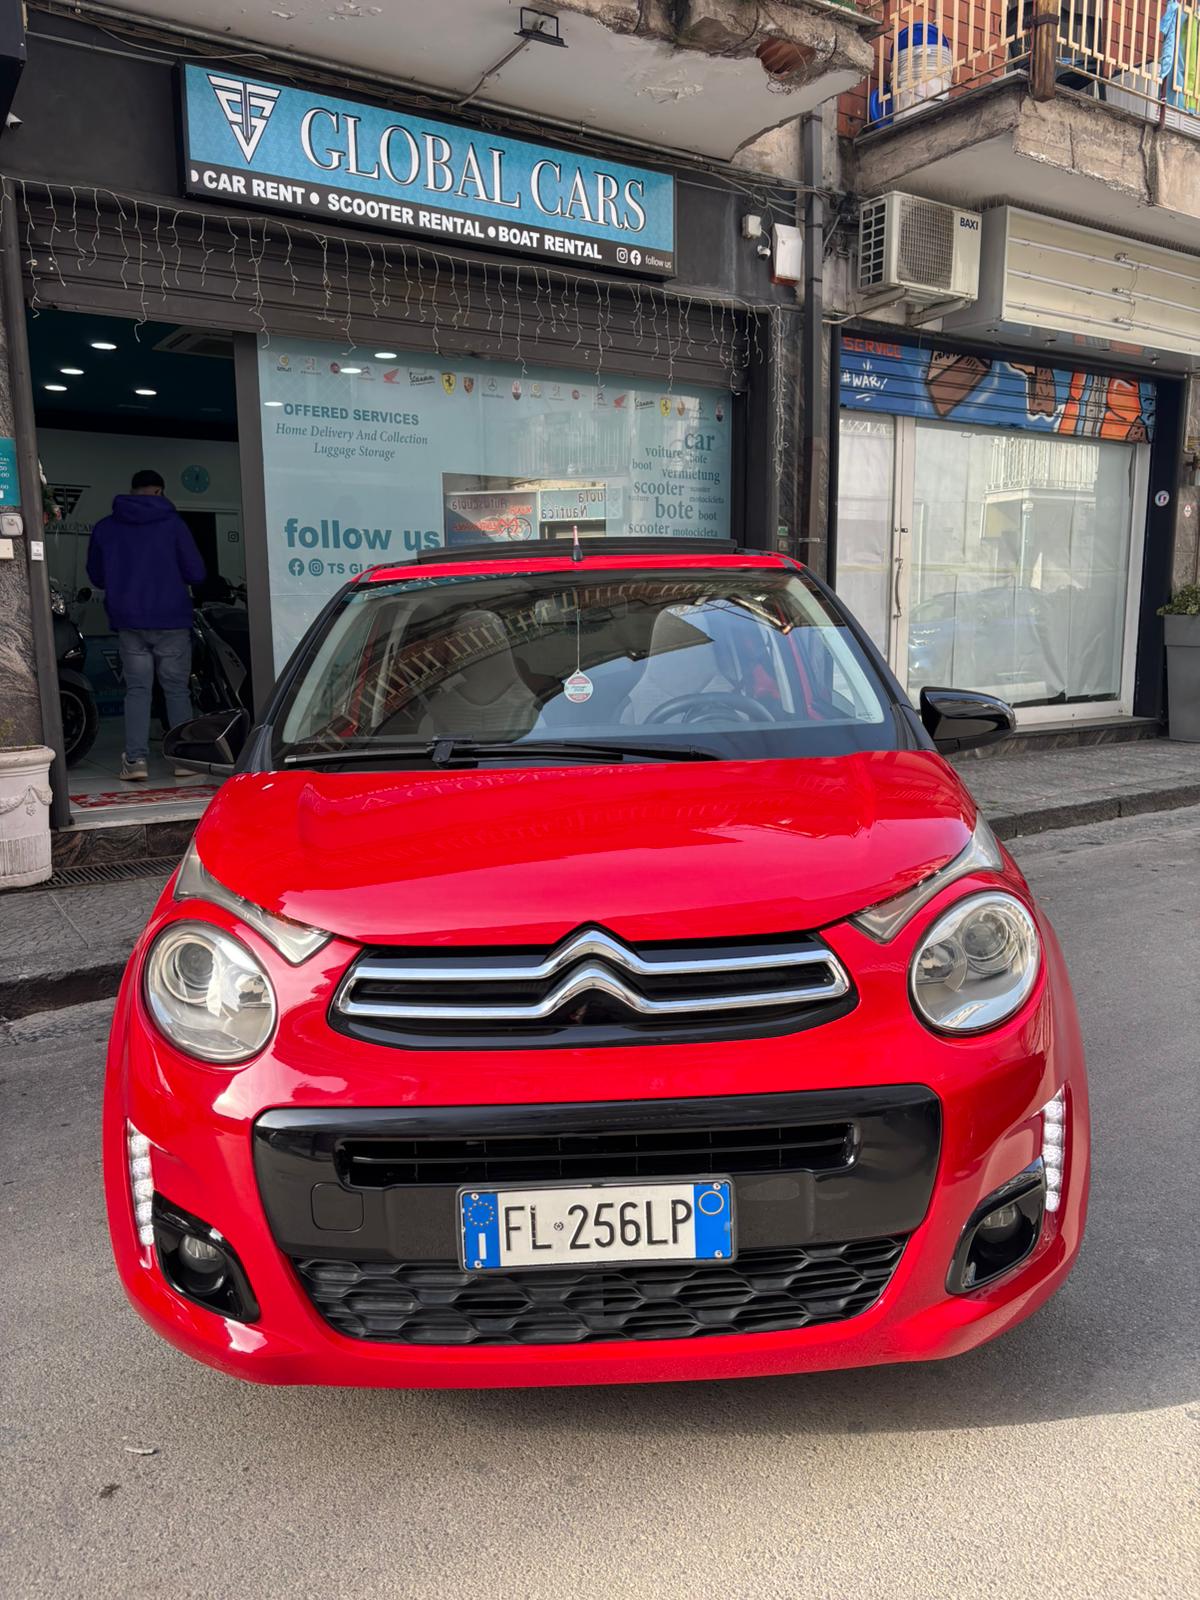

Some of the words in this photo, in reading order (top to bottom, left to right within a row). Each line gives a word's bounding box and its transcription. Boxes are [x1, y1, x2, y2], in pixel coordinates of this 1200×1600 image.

[301, 107, 521, 209] GLOBAL
[530, 159, 647, 232] CARS
[203, 169, 246, 194] CAR
[252, 179, 305, 204] RENT
[328, 193, 414, 225] SCOOTER
[419, 209, 484, 238] RENTAL
[498, 226, 540, 248] BOAT
[544, 235, 602, 259] RENTAL
[960, 217, 979, 230] BAXI
[645, 254, 664, 266] follow
[664, 260, 672, 268] us
[283, 403, 349, 420] OFFERED
[352, 408, 419, 426] SERVICES
[275, 422, 308, 437] Home
[310, 425, 353, 442] Delivery
[355, 428, 378, 441] And
[379, 430, 428, 446] Collection
[684, 433, 716, 451] car
[314, 442, 357, 459] Luggage
[358, 446, 396, 461] Storage
[645, 445, 683, 458] voiture
[632, 458, 652, 471] boot
[662, 467, 720, 485] vermietung
[634, 481, 685, 496] scooter
[654, 496, 693, 519] bote
[698, 510, 717, 520] boot
[284, 518, 392, 550] follow
[403, 529, 441, 550] us
[628, 522, 670, 534] scooter
[672, 527, 718, 538] motocicleta
[328, 563, 345, 574] TS
[504, 1204, 552, 1251] FL
[568, 1199, 692, 1250] 256LP
[478, 1233, 487, 1260] I
